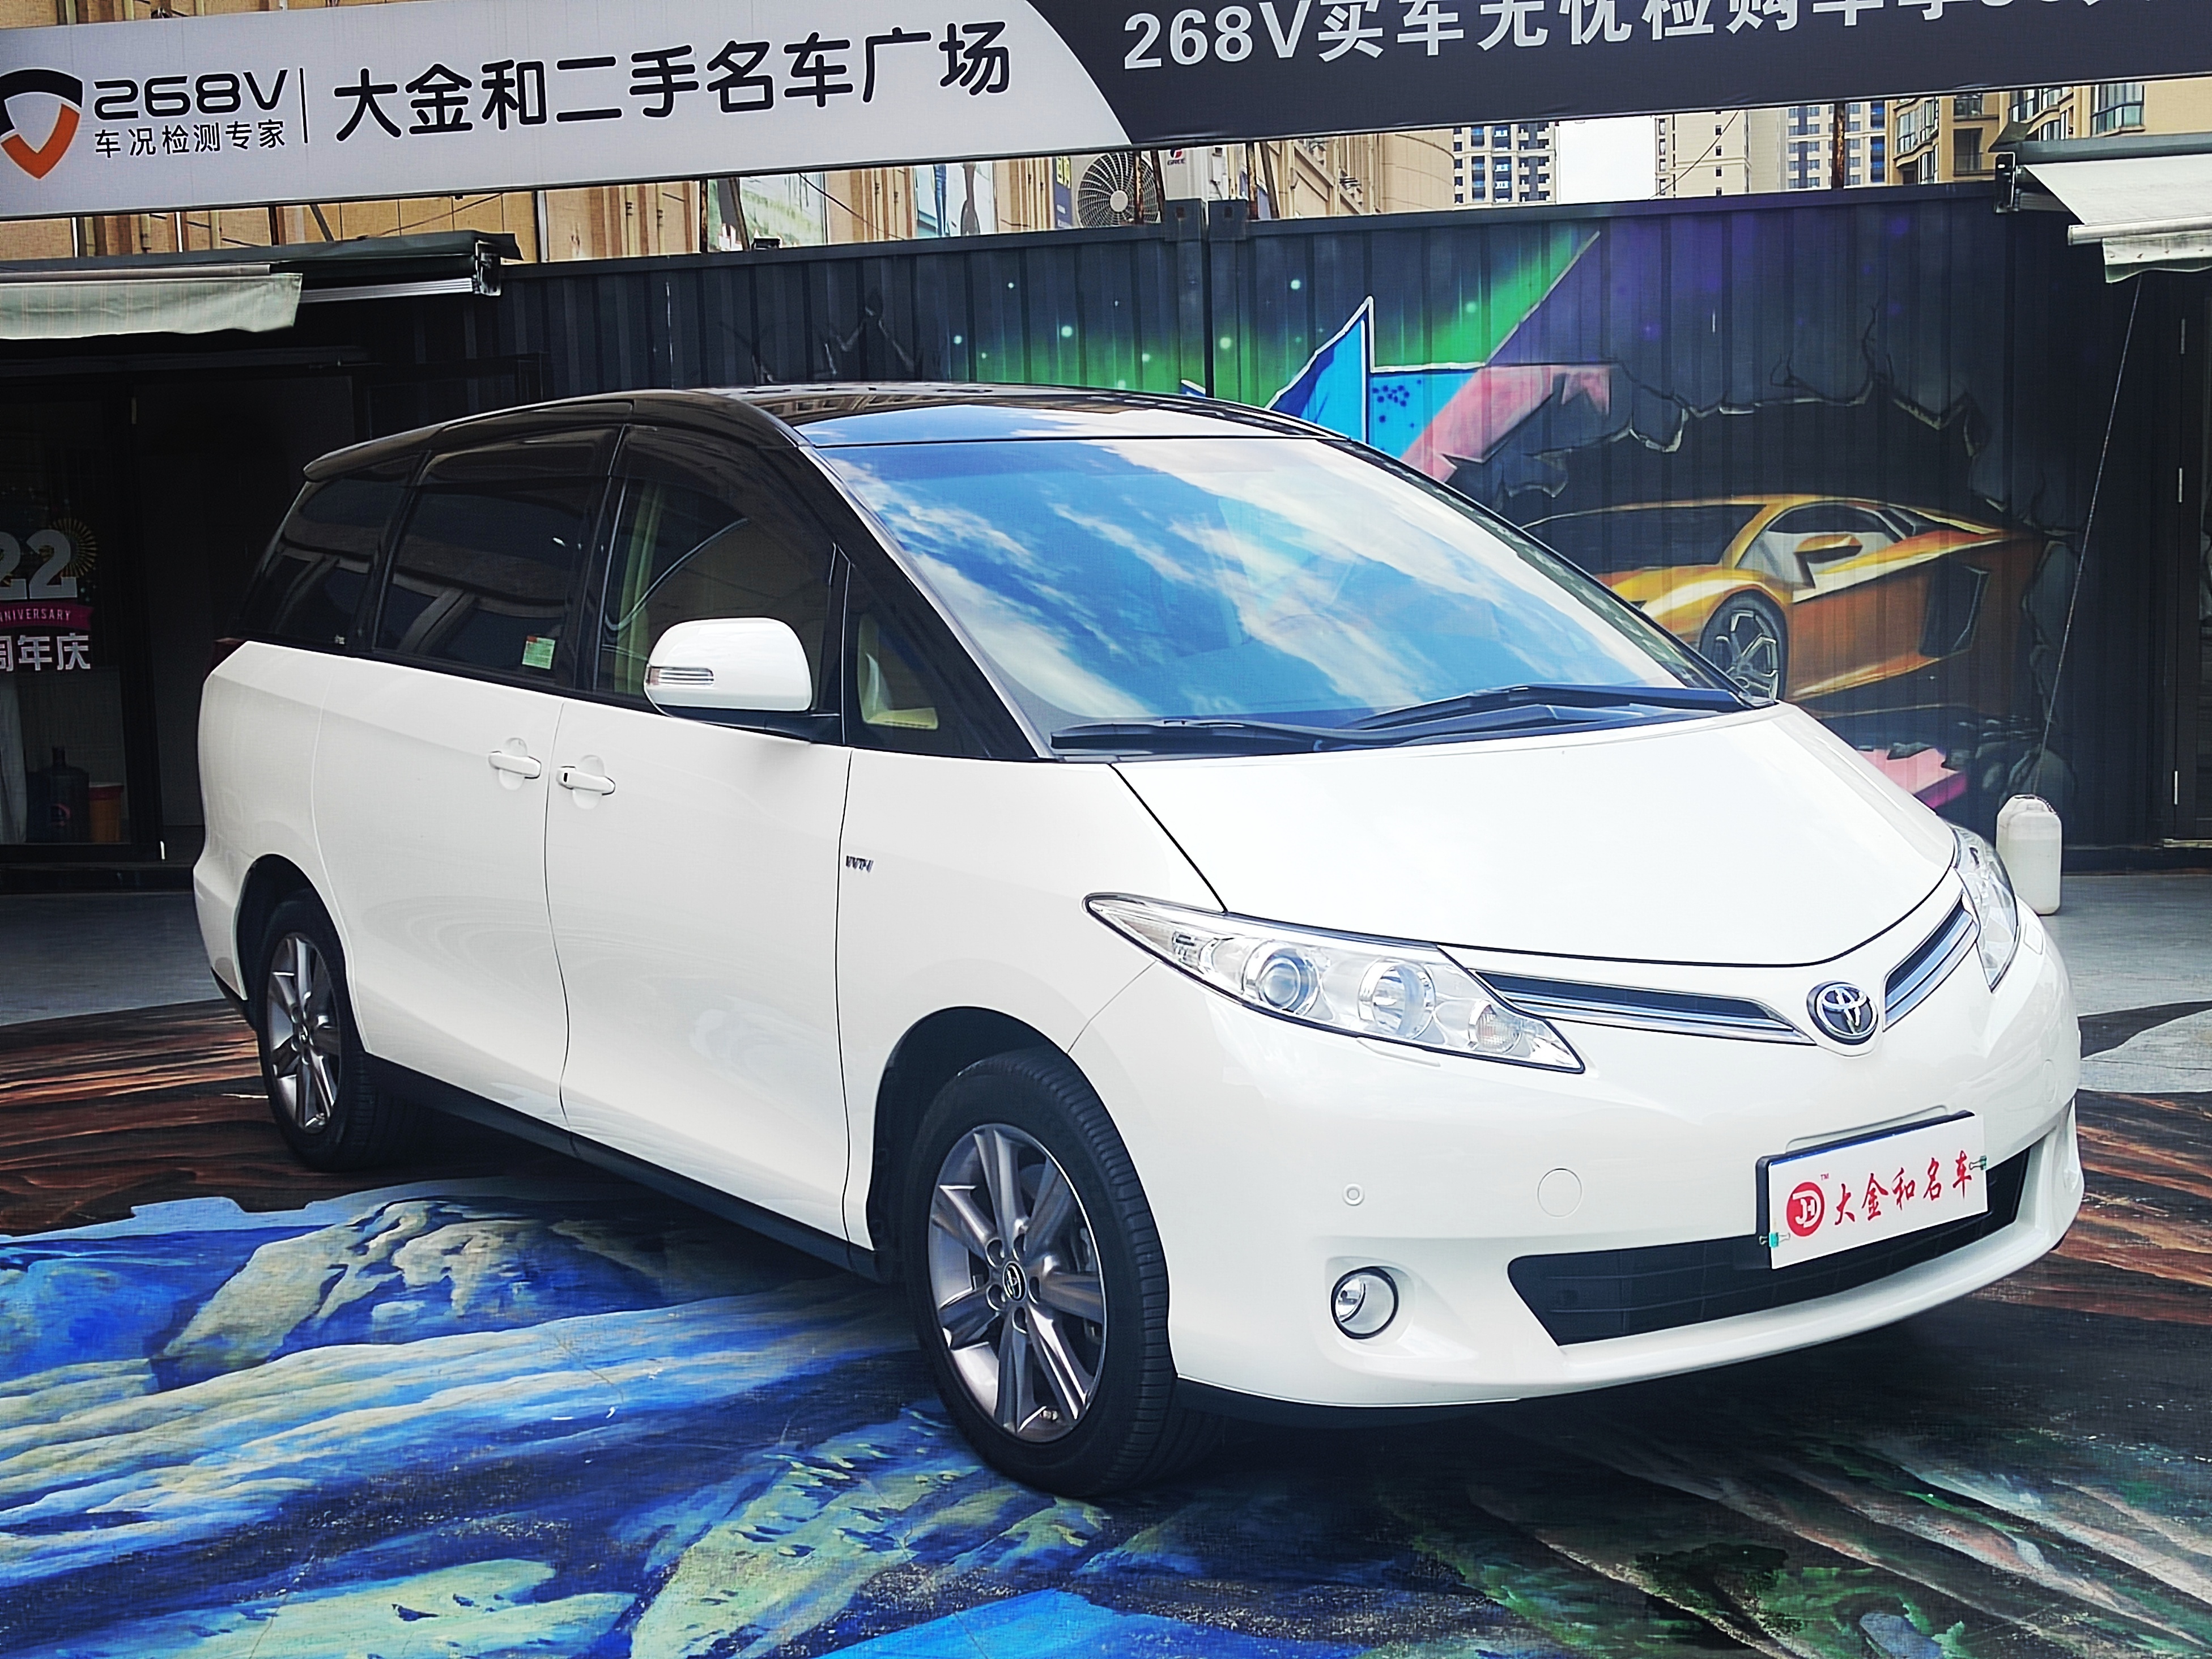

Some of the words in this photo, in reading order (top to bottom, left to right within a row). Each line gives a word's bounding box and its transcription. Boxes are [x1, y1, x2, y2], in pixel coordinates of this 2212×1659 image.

[94, 70, 287, 120] 268V
[334, 22, 1010, 142] 大金和二手名车广场
[95, 120, 285, 158] 车况检测专家
[1835, 1150, 1972, 1226] 大金和名车
